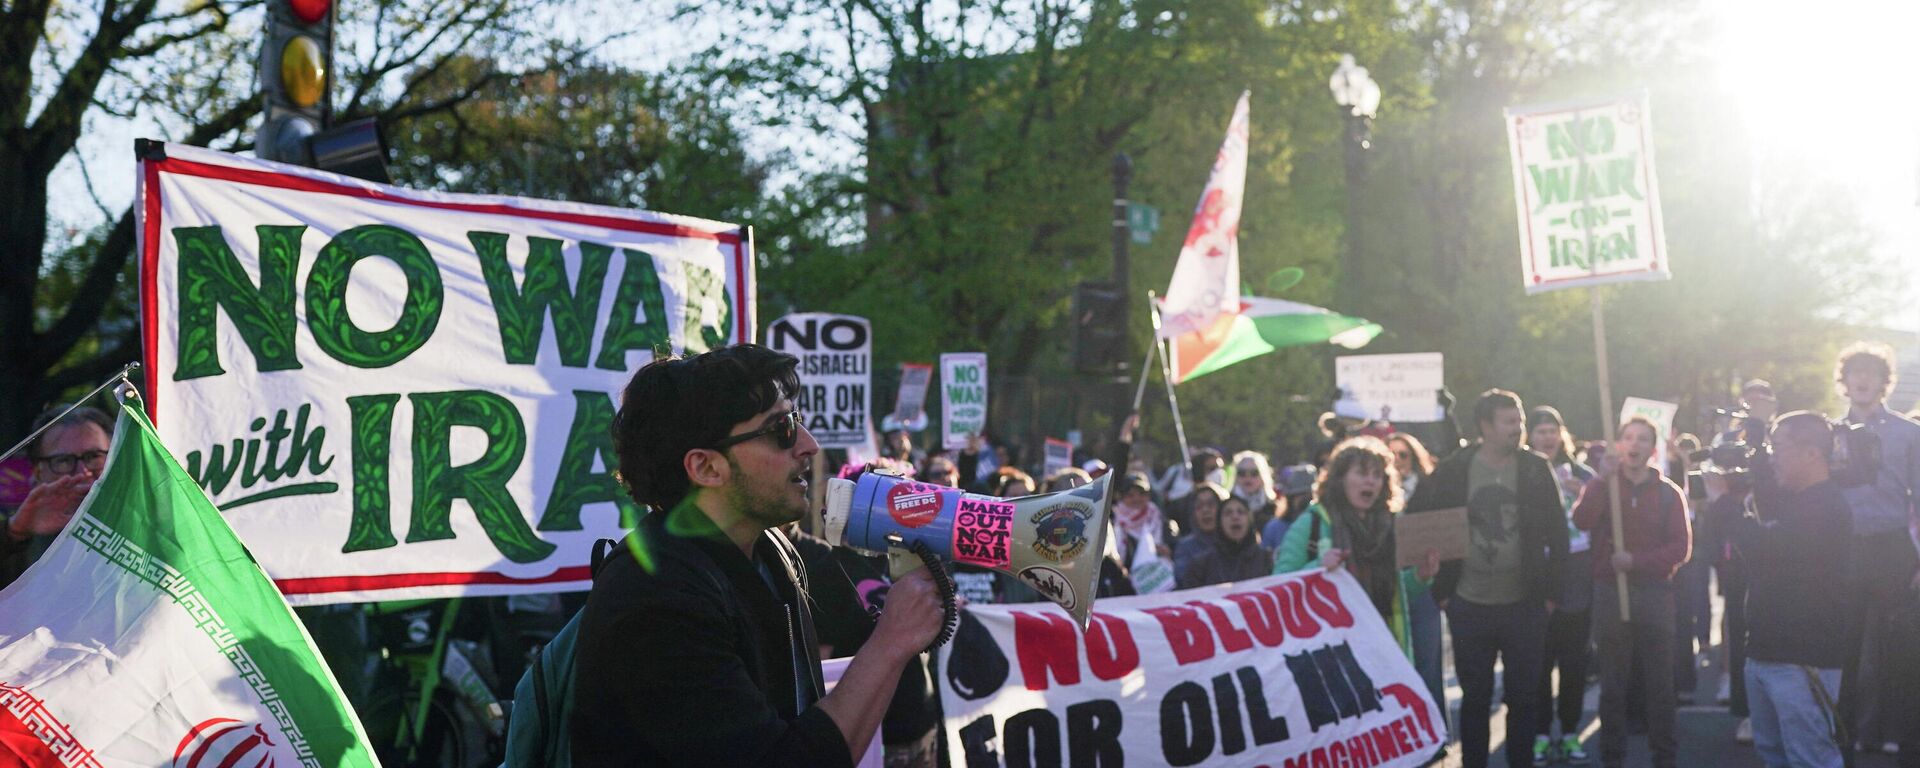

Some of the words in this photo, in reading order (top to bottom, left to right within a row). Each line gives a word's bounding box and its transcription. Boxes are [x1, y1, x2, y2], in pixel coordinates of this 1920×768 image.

[1546, 116, 1615, 160] NO
[1528, 152, 1645, 215] WAR
[1547, 224, 1639, 270] IRAN
[172, 224, 444, 381] NO
[467, 231, 733, 370] WAR
[774, 319, 867, 350] NO
[797, 353, 867, 375] -ISRAELI
[955, 364, 979, 383] NO
[798, 384, 826, 412] AR
[836, 384, 864, 411] ON
[801, 413, 865, 430] AN!
[186, 403, 336, 497] with
[343, 389, 648, 563] IRA
[895, 499, 921, 511] FREE
[922, 497, 936, 505] DC
[960, 501, 1013, 515] MAKE
[959, 512, 1012, 529] OUT
[957, 527, 1010, 546] NOT
[956, 543, 1008, 561] WAR
[1008, 611, 1140, 691] NO
[1139, 572, 1354, 666] BLOOD
[959, 699, 1124, 768] FOR
[1160, 666, 1290, 767] OIL
